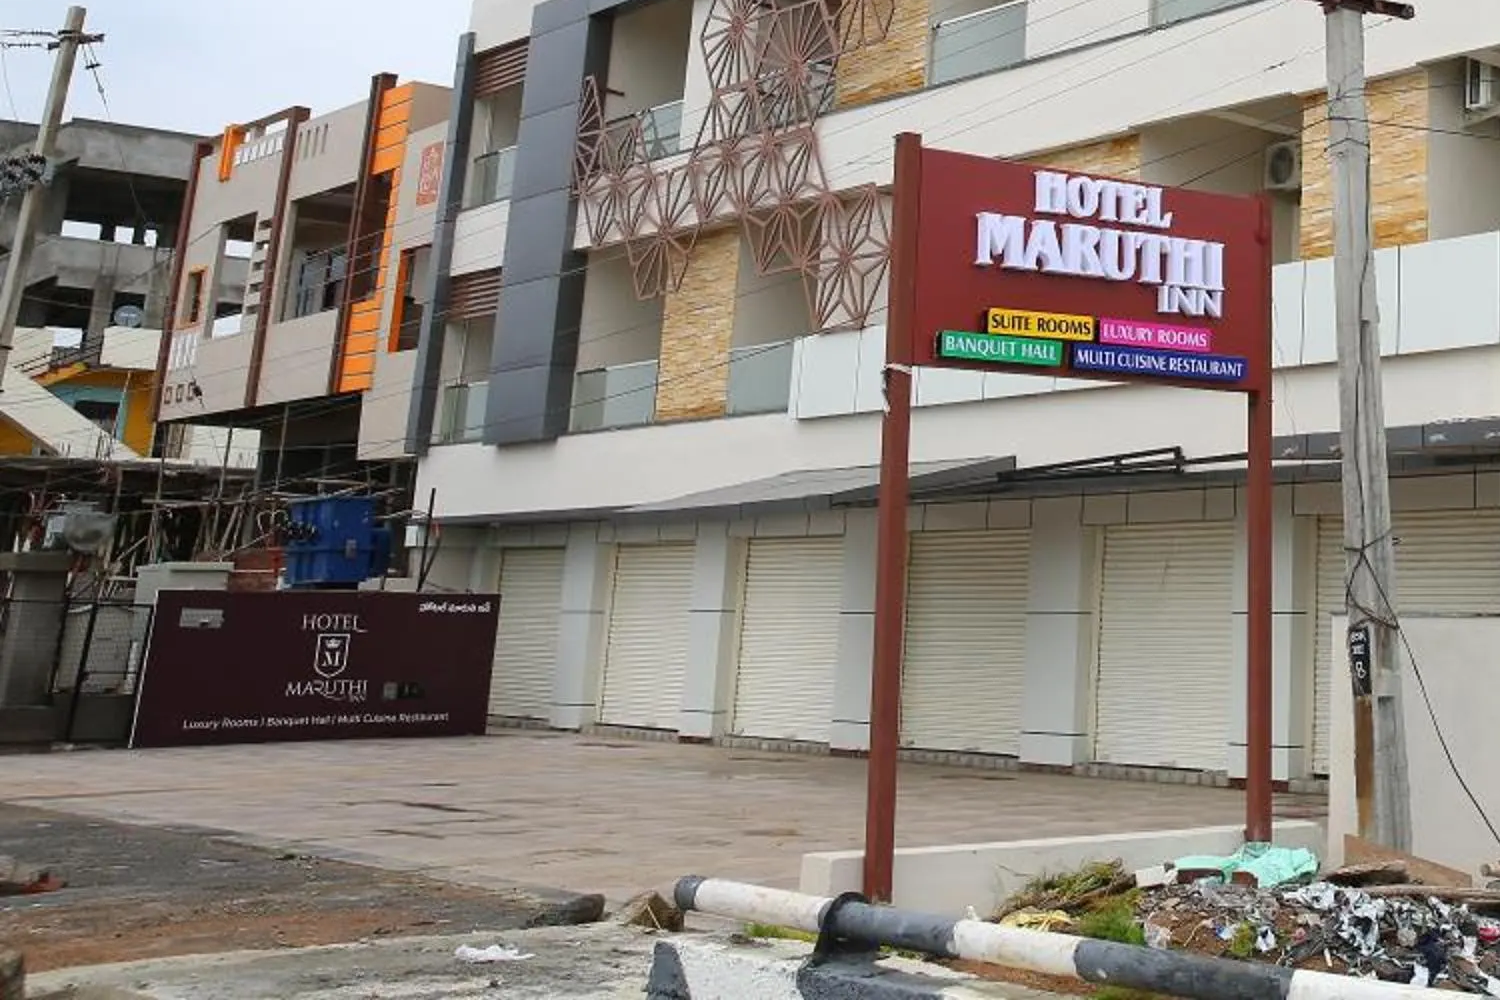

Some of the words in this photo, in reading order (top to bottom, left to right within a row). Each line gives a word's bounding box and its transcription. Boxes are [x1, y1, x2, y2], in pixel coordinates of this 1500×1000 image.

[1034, 170, 1173, 229] HOTEL
[973, 211, 1226, 292] MARUTHI
[1157, 284, 1223, 319] INN
[991, 313, 1032, 331] SUITE
[1037, 317, 1092, 335] ROOMS
[1102, 322, 1153, 342] LUXURY
[1157, 329, 1208, 348] ROOMS
[944, 335, 1016, 357] BANQUET
[1020, 342, 1057, 361] HALL
[1074, 348, 1116, 367] MULTI
[1117, 353, 1167, 372] CUISINE
[1168, 356, 1245, 378] RESTAURANT
[301, 613, 369, 633] HOTEL
[321, 650, 341, 667] M
[284, 679, 369, 700] MARUTHI
[182, 718, 219, 731] Luxury
[221, 716, 259, 729] Rooms
